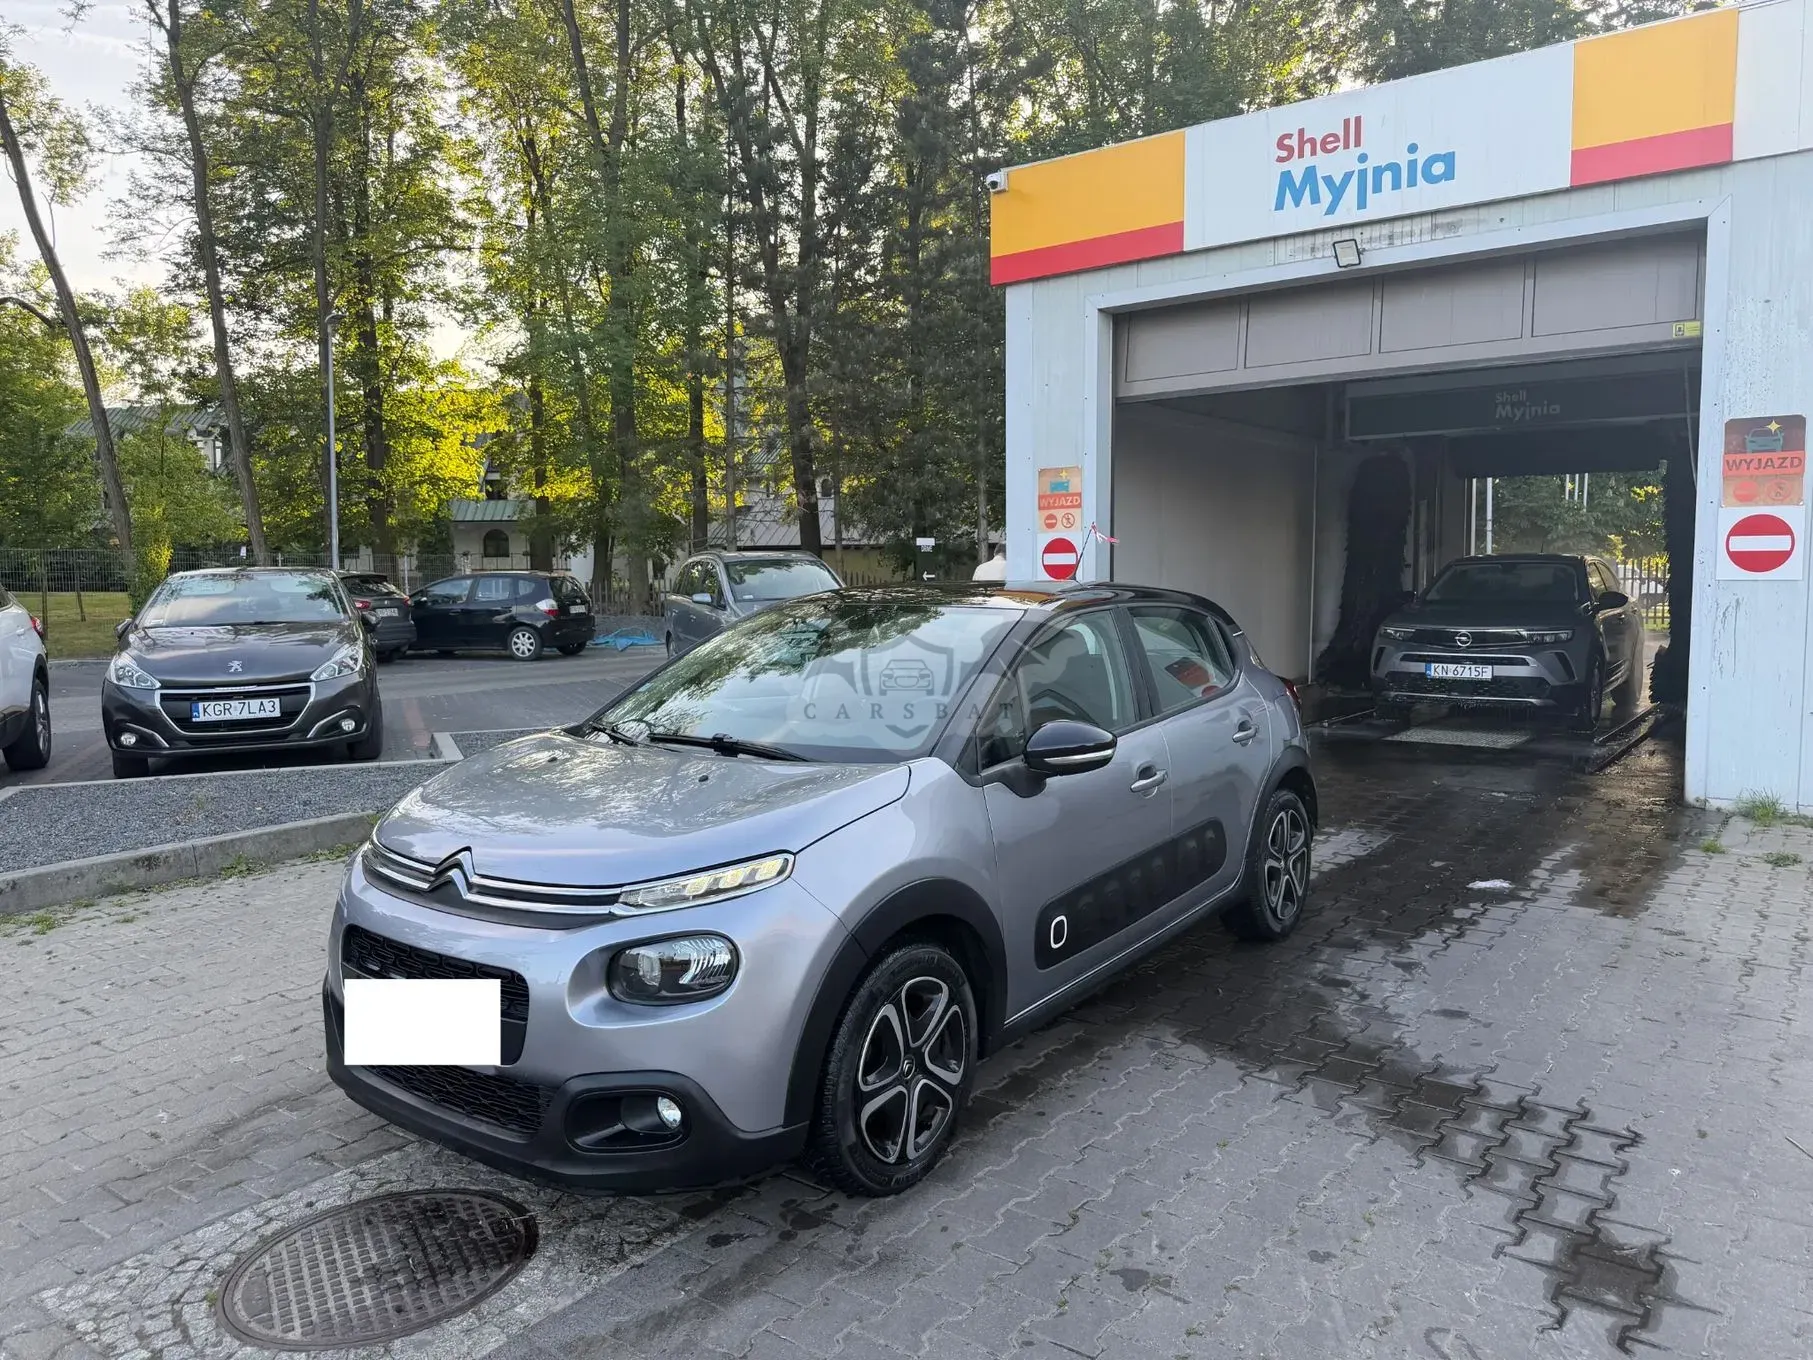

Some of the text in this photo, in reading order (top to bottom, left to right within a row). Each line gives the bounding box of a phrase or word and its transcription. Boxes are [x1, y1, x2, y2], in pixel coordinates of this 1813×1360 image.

[1275, 115, 1362, 163] Shell
[1274, 142, 1456, 216] Myjnia
[1495, 389, 1527, 403] Shell
[1495, 400, 1561, 422] Myjnia
[1725, 455, 1803, 472] WYJAZD
[1040, 495, 1081, 508] WYJAZD
[1433, 665, 1488, 677] KN 6715F
[203, 700, 276, 717] KGR 7LA3
